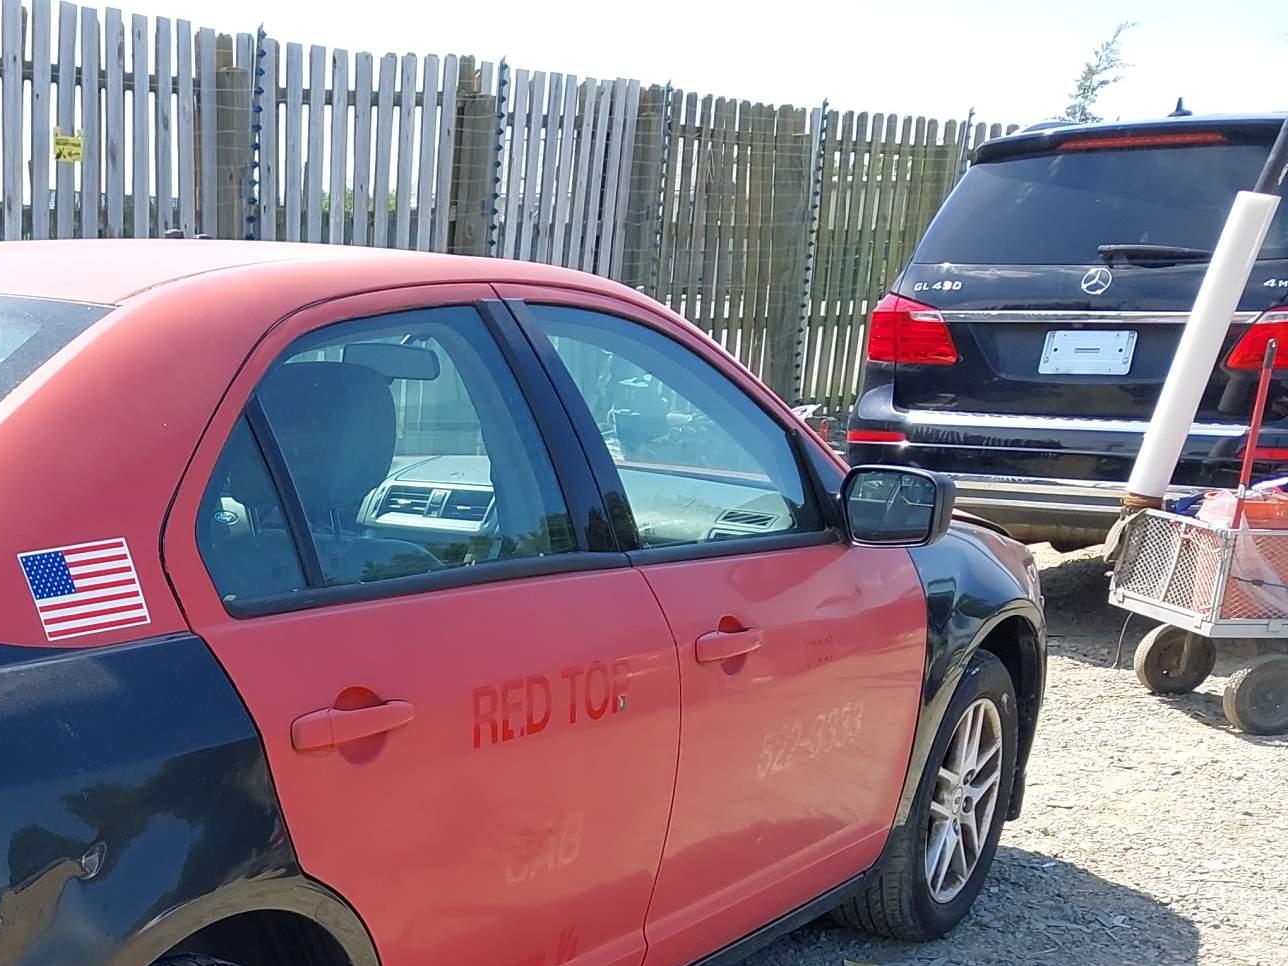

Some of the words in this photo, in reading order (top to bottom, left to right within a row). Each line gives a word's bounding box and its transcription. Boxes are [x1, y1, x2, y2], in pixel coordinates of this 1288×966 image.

[913, 282, 930, 291] GL
[471, 673, 553, 750] RED
[560, 659, 631, 724] TOP
